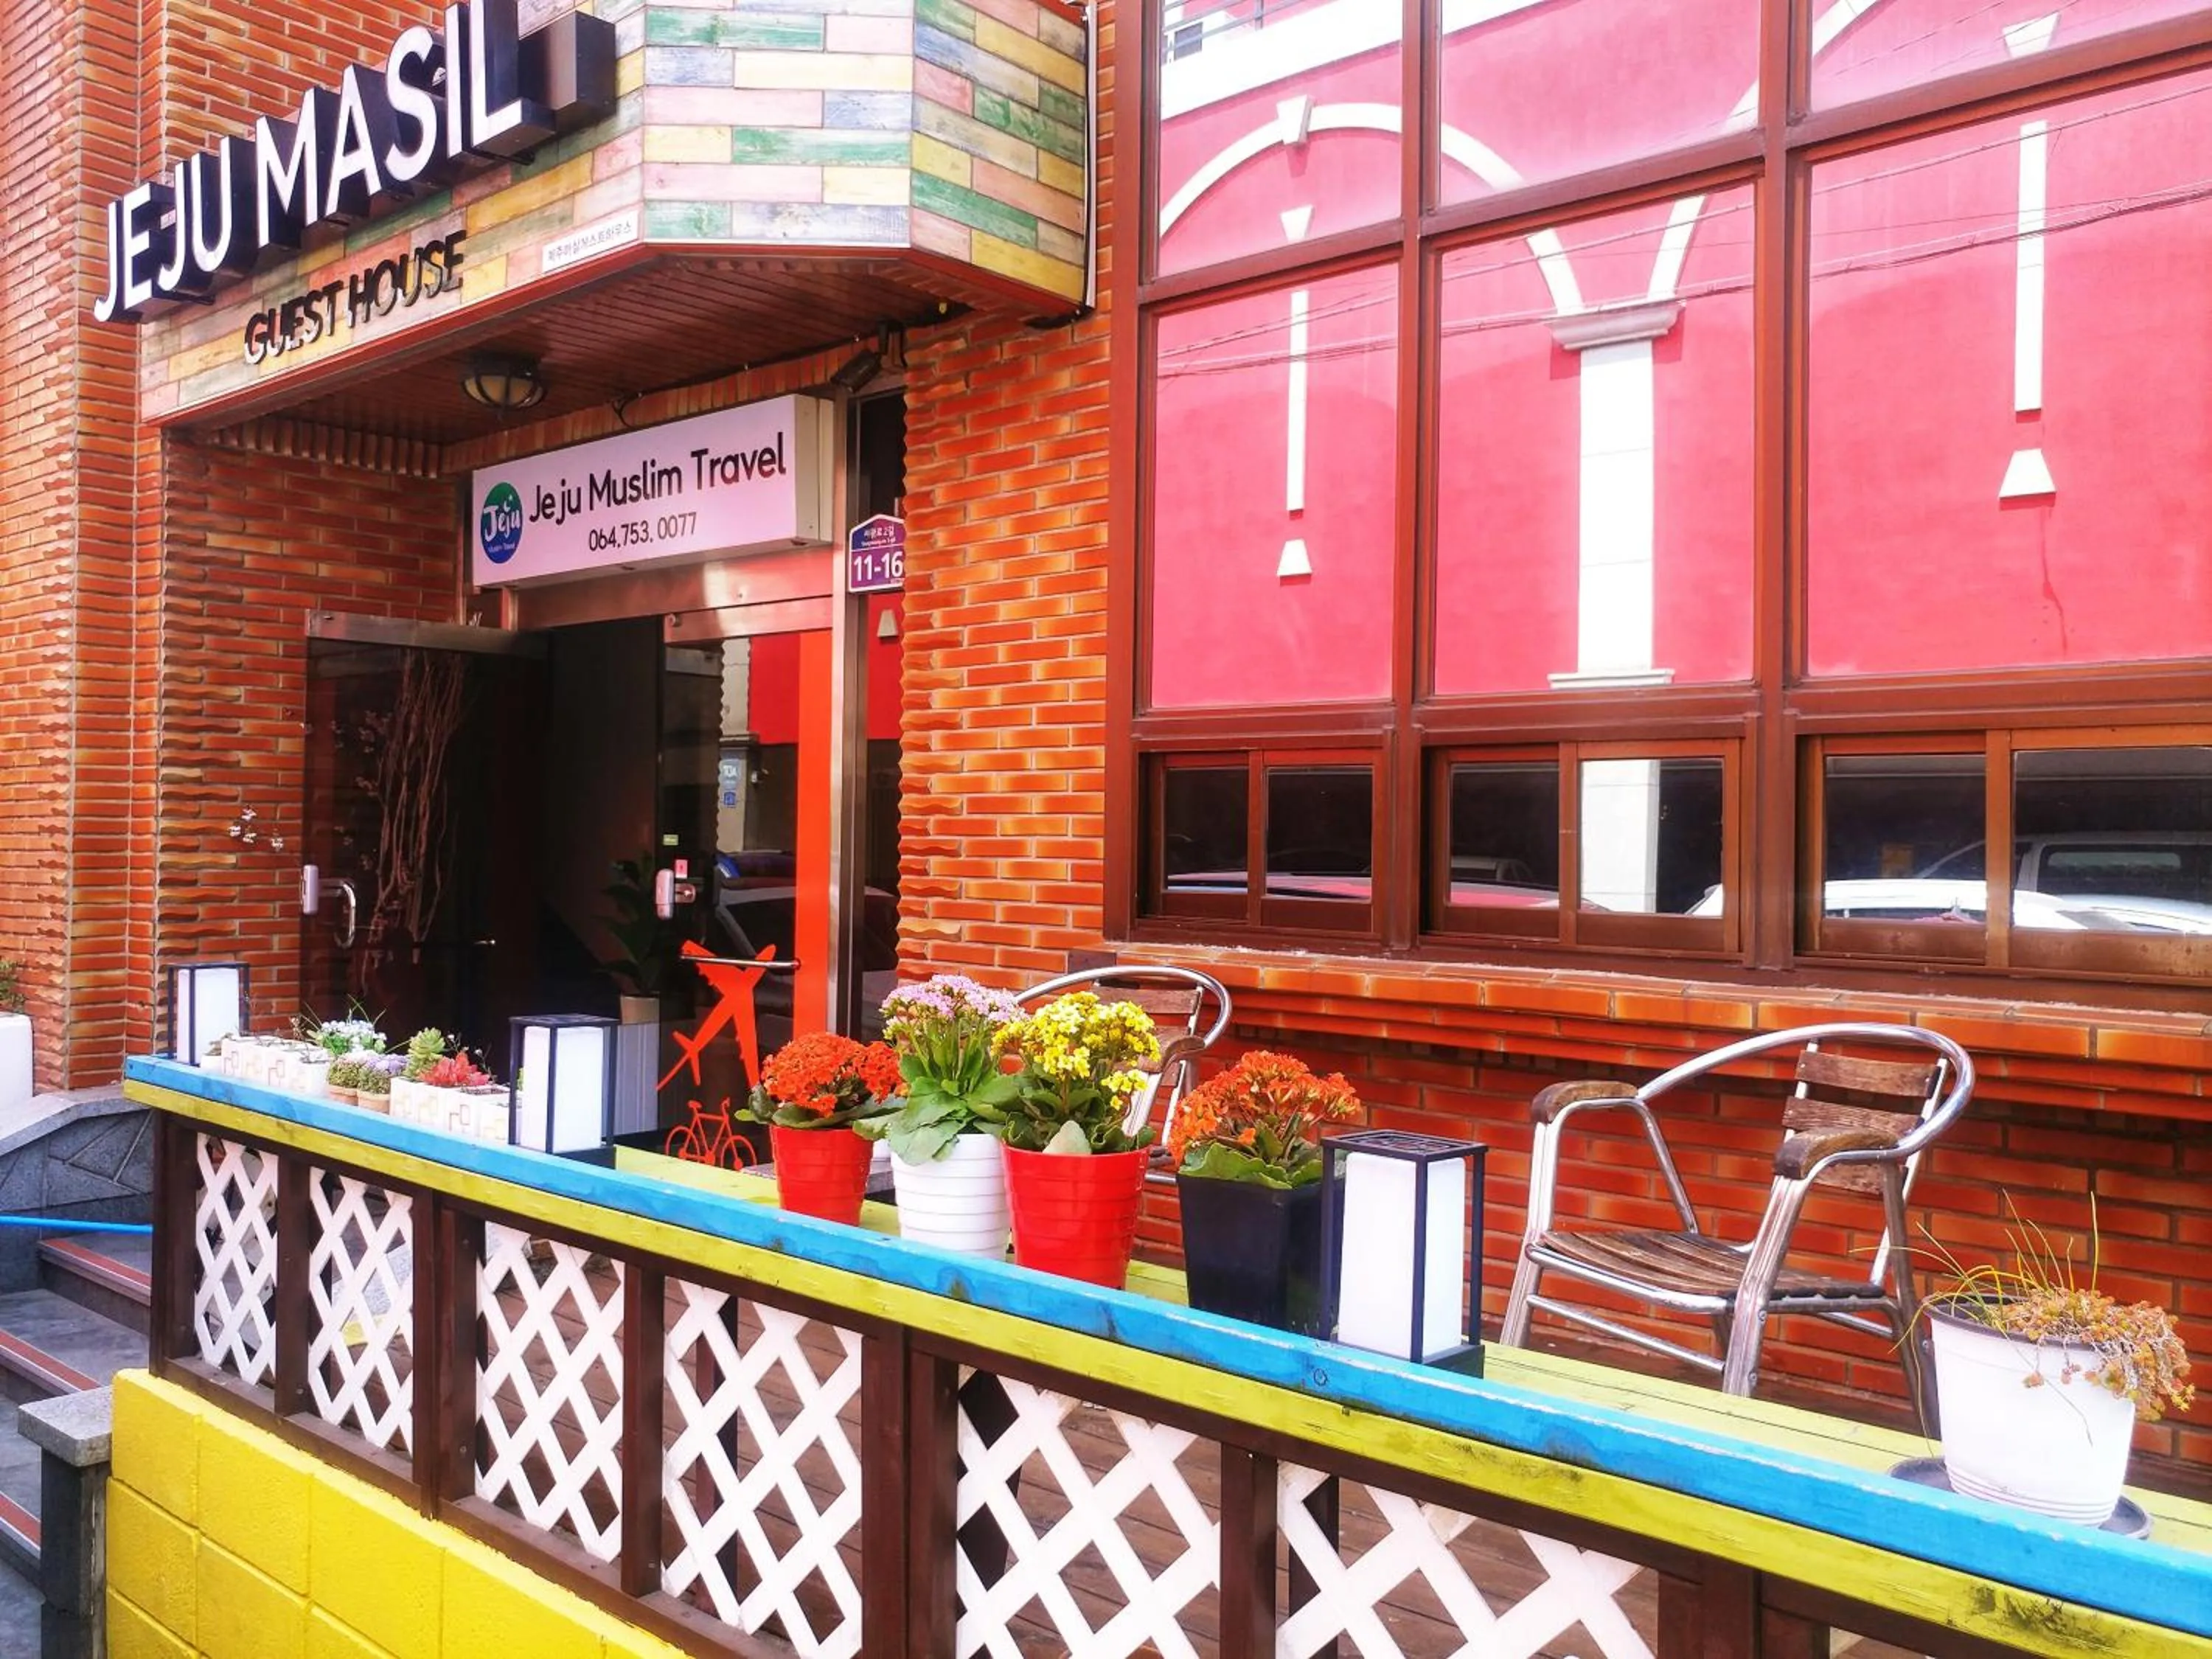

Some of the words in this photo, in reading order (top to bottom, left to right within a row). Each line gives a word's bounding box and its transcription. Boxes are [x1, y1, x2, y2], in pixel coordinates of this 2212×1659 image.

[94, 135, 232, 322] JEJU
[255, 0, 522, 249] MASIL
[244, 279, 344, 365] GUEST
[348, 229, 467, 329] HOUSE
[483, 504, 521, 542] Jeju
[529, 479, 582, 526] Jeju
[589, 459, 683, 511] Muslim
[690, 431, 787, 490] Travel
[853, 551, 903, 582] 11-16
